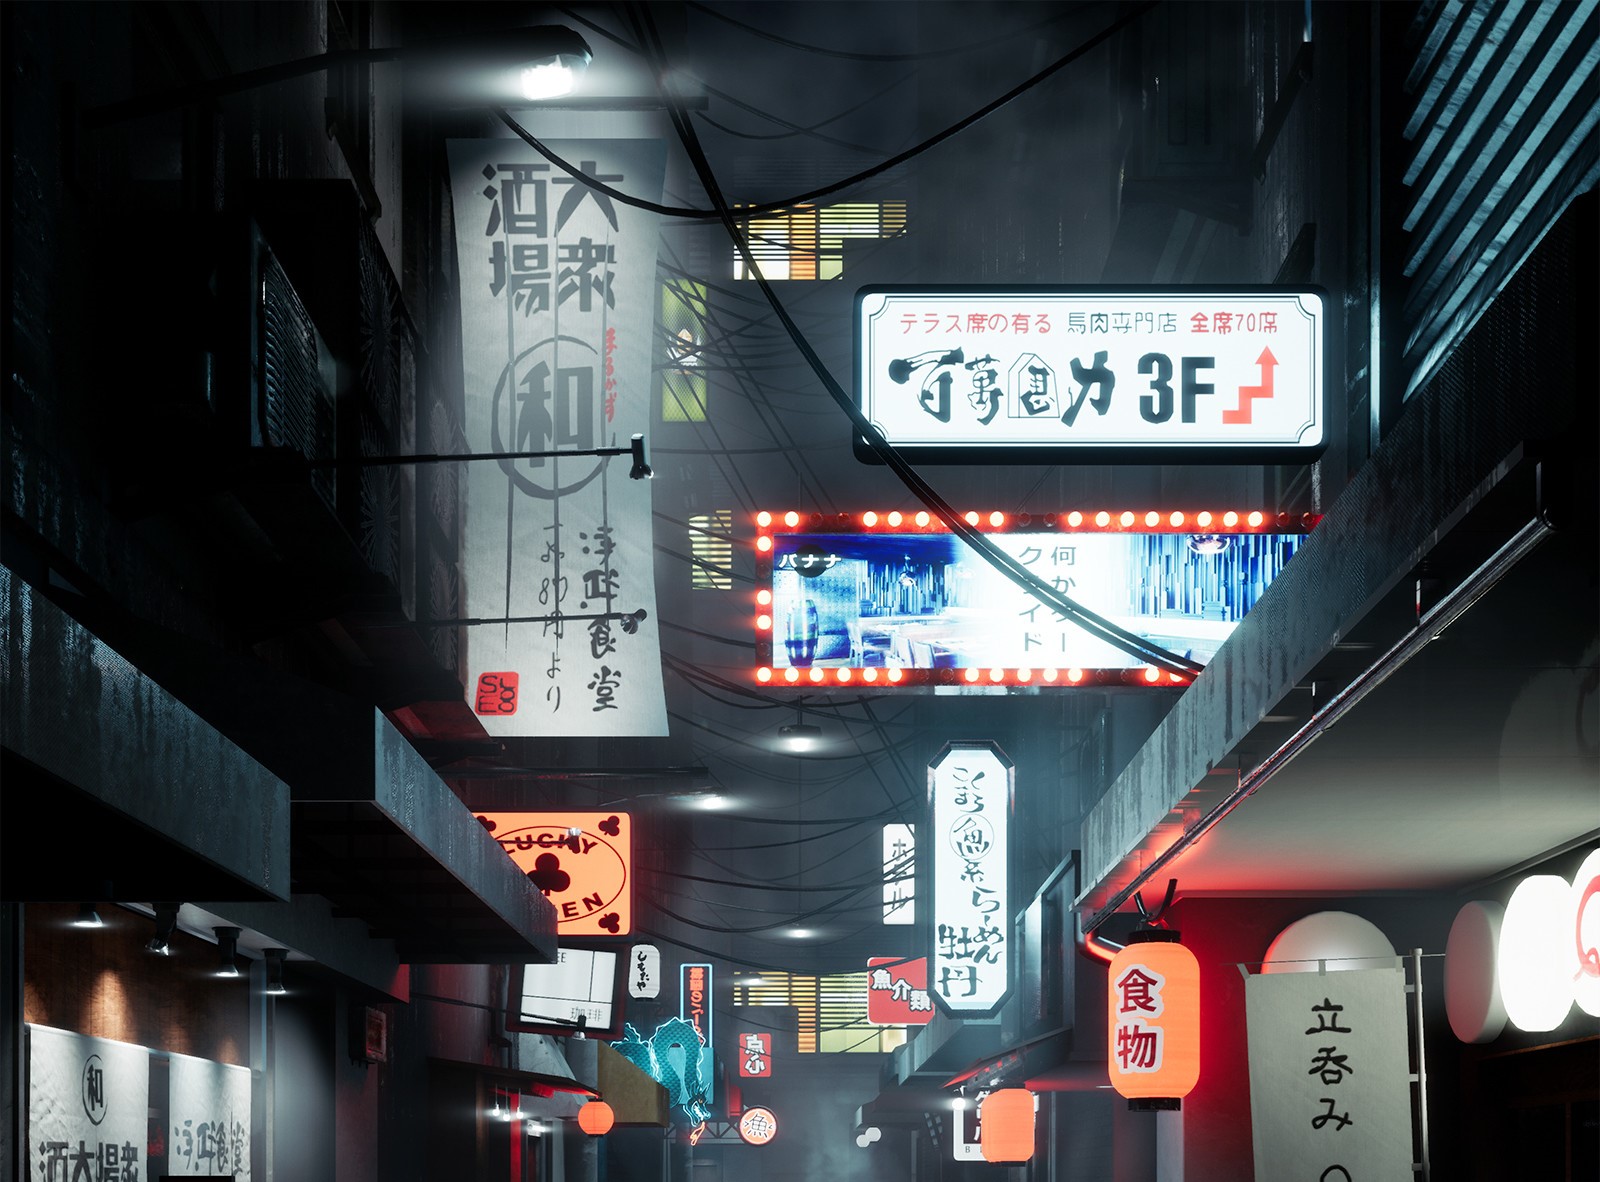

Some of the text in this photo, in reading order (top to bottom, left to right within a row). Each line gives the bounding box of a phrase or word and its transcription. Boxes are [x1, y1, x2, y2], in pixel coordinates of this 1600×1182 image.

[481, 163, 551, 318] 酒場
[551, 160, 624, 312] 大衆
[900, 312, 1052, 335] テラス席の有る
[1190, 311, 1278, 335] 全席70席
[516, 360, 594, 468] 和
[1137, 352, 1215, 425] 3F
[1018, 546, 1043, 652] クイド
[871, 968, 932, 1011] 魚介類
[1117, 968, 1159, 1069] 食物
[1305, 997, 1353, 1131] 立呑み
